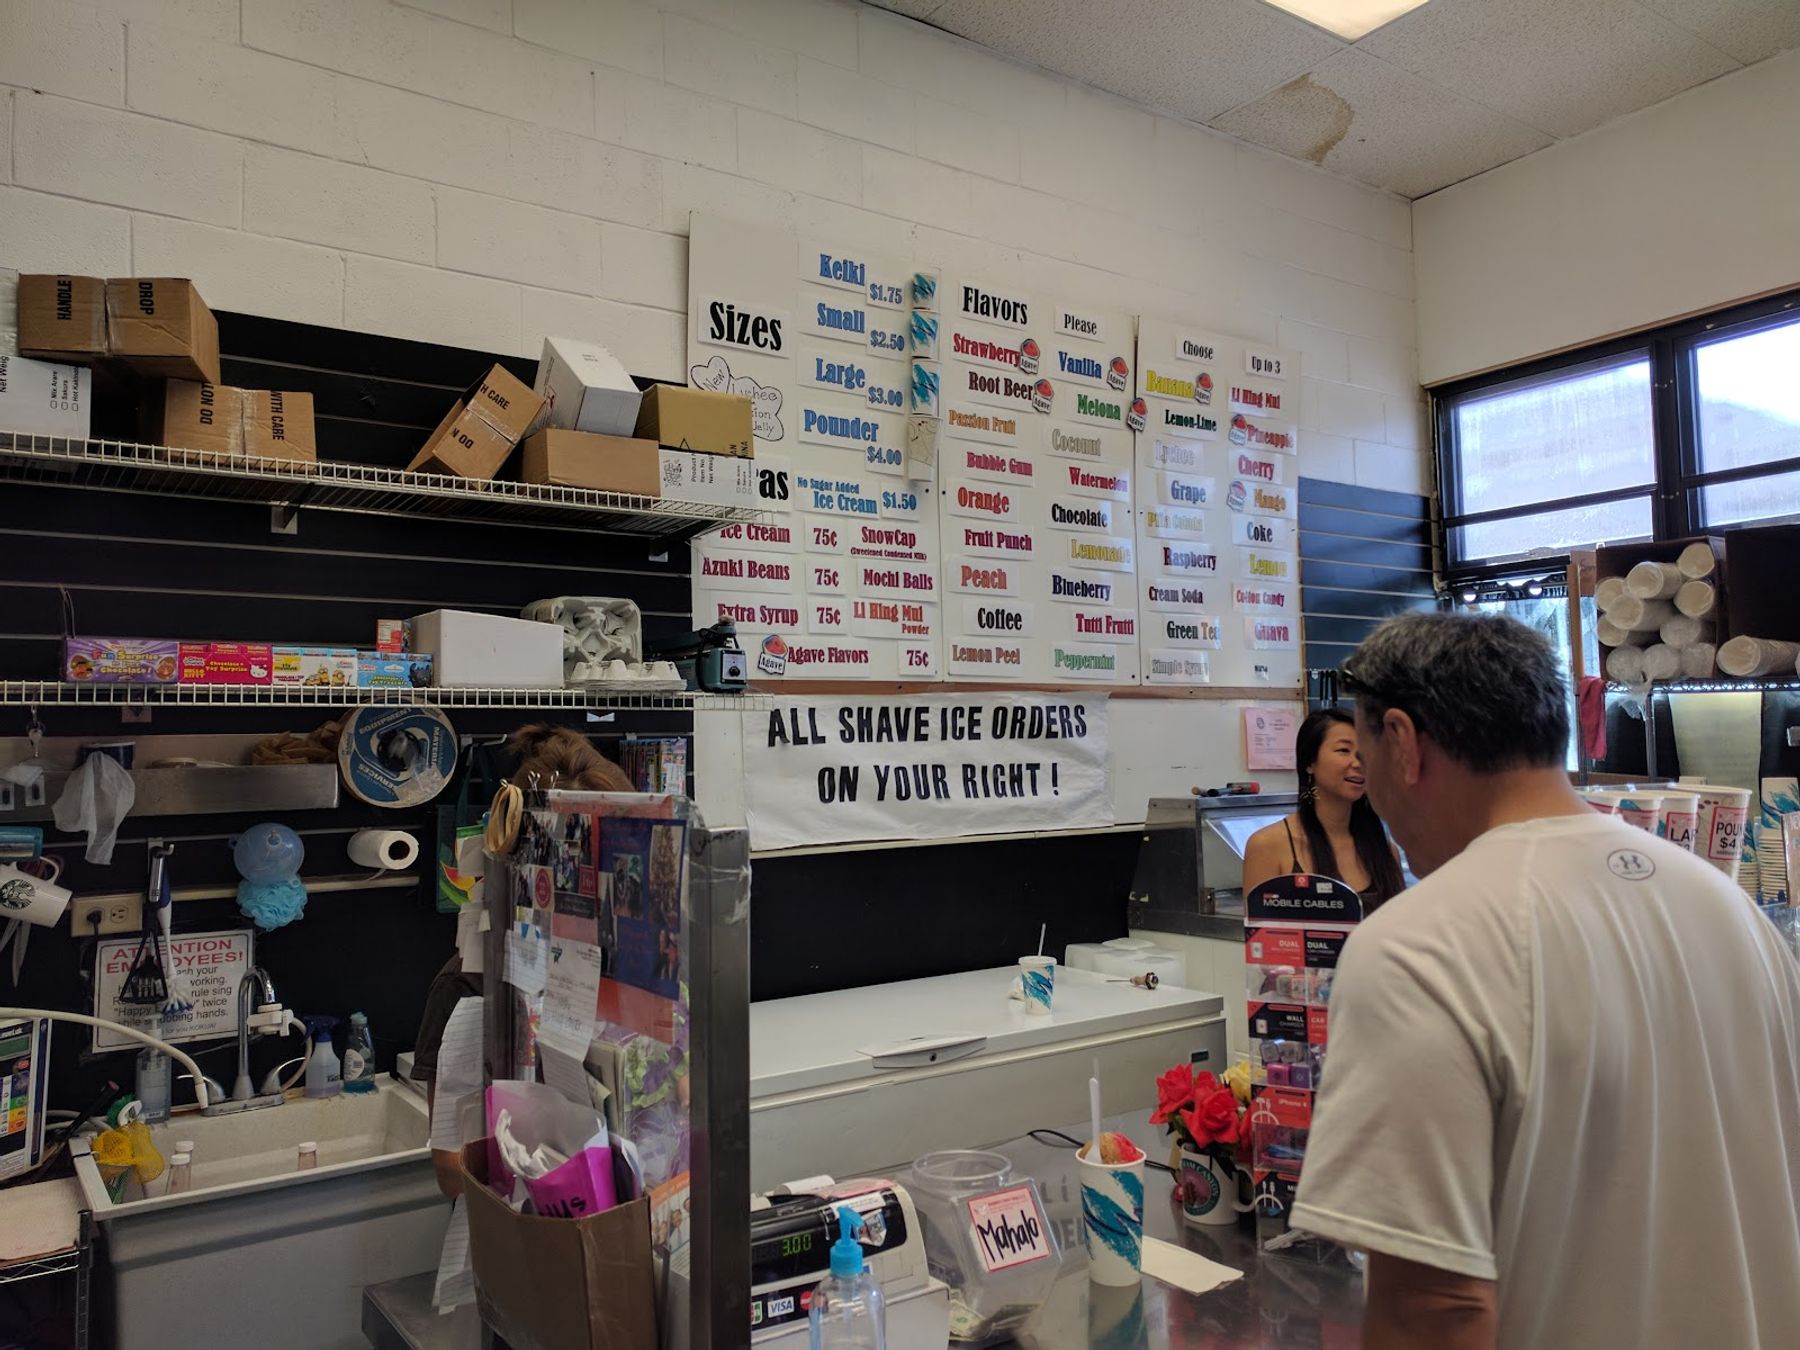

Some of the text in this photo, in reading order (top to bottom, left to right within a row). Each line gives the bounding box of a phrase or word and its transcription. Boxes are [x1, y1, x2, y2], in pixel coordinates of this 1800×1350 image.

[819, 253, 866, 287] Keiki
[57, 279, 72, 320] HANDLE
[139, 281, 154, 316] DROP
[869, 283, 903, 305] $1.75
[962, 286, 1029, 326] Flavors
[709, 301, 782, 352] Sizes
[817, 302, 865, 334] Small
[1064, 313, 1098, 336] Please
[870, 330, 905, 352] $2.50
[953, 333, 1021, 368] Strawberry
[1183, 340, 1214, 360] Choose
[815, 358, 866, 390] Large
[1058, 351, 1103, 380] Vanilla
[1251, 356, 1281, 374] Up to 3
[969, 371, 1034, 401] Root Beer
[1146, 370, 1196, 399] Banana
[200, 382, 214, 426] DO NOT
[487, 390, 511, 410] CARE
[868, 387, 903, 407] $3.00
[1077, 394, 1121, 421] Melona
[1231, 387, 1281, 409] Li Hing Mui
[270, 390, 284, 441] WITH CARE
[803, 408, 880, 442] Pounder
[949, 409, 1017, 435] Passion Fruit
[1165, 409, 1217, 432] Lemon-Lime
[458, 434, 475, 449] DO
[1052, 428, 1102, 457] Coconut
[1247, 424, 1294, 450] Pineapple
[867, 446, 903, 466] $4.00
[967, 451, 1033, 477] Bubble Gum
[1238, 454, 1275, 481] Cherry
[797, 477, 860, 495] No Sugar Added
[1069, 466, 1129, 492] Watermelon
[813, 491, 878, 514] Ice Cream
[882, 491, 918, 511] $1.50
[958, 486, 1010, 514] Orange
[1171, 480, 1207, 504] Grape
[1254, 488, 1287, 511] Mango
[1051, 503, 1108, 528] Chocolate
[720, 523, 791, 543] Ice Cream
[813, 527, 838, 547] 75¢
[861, 526, 917, 549] SnowCap
[964, 529, 1032, 551] Fruit Punch
[1246, 521, 1273, 543] Coke
[1071, 538, 1132, 564] Lemonade
[1163, 547, 1217, 571] Raspberry
[702, 556, 791, 581] Azuki Beans
[1249, 554, 1288, 577] Lemon
[814, 568, 839, 587] 75¢
[863, 569, 934, 591] Mochi Balls
[961, 565, 1007, 590] Peach
[1052, 574, 1111, 602] Blueberry
[1149, 586, 1204, 604] Cream Soda
[1236, 590, 1285, 608] Cotton Candy
[718, 603, 799, 627] Extra Syrup
[816, 607, 841, 626] 75¢
[853, 601, 924, 622] Li Hing Mui
[977, 607, 1023, 631] Coffee
[901, 624, 930, 636] Powder
[1076, 613, 1135, 636] Tutti Frutti
[1167, 621, 1220, 641] Green Tea
[1255, 622, 1289, 642] Guava
[92, 650, 159, 661] Fun Surprise
[761, 655, 784, 672] Agave
[788, 646, 869, 665] Agave Flavors
[906, 650, 930, 667] 75¢
[952, 645, 1021, 665] Lemon Peel
[1054, 649, 1115, 670] Peppermint
[1184, 660, 1208, 677] Syru
[768, 704, 1087, 747] ALL SHAVE ICE ORDERS
[817, 765, 859, 804] ON
[873, 763, 951, 802] YOUR
[961, 762, 1041, 799] RIGHT
[1719, 837, 1737, 849] $4
[1263, 898, 1345, 909] MOBILE CABLES
[113, 939, 232, 960] ATNTION
[1307, 941, 1329, 949] DUAL
[106, 951, 244, 974] EMOYEES!
[196, 966, 217, 977] your
[191, 986, 232, 998] rule sing
[202, 998, 228, 1007] twice
[196, 1009, 229, 1019] hands.
[782, 1233, 812, 1257] 3.00
[977, 1210, 1039, 1263] Mahalo
[770, 1301, 793, 1313] VISA
